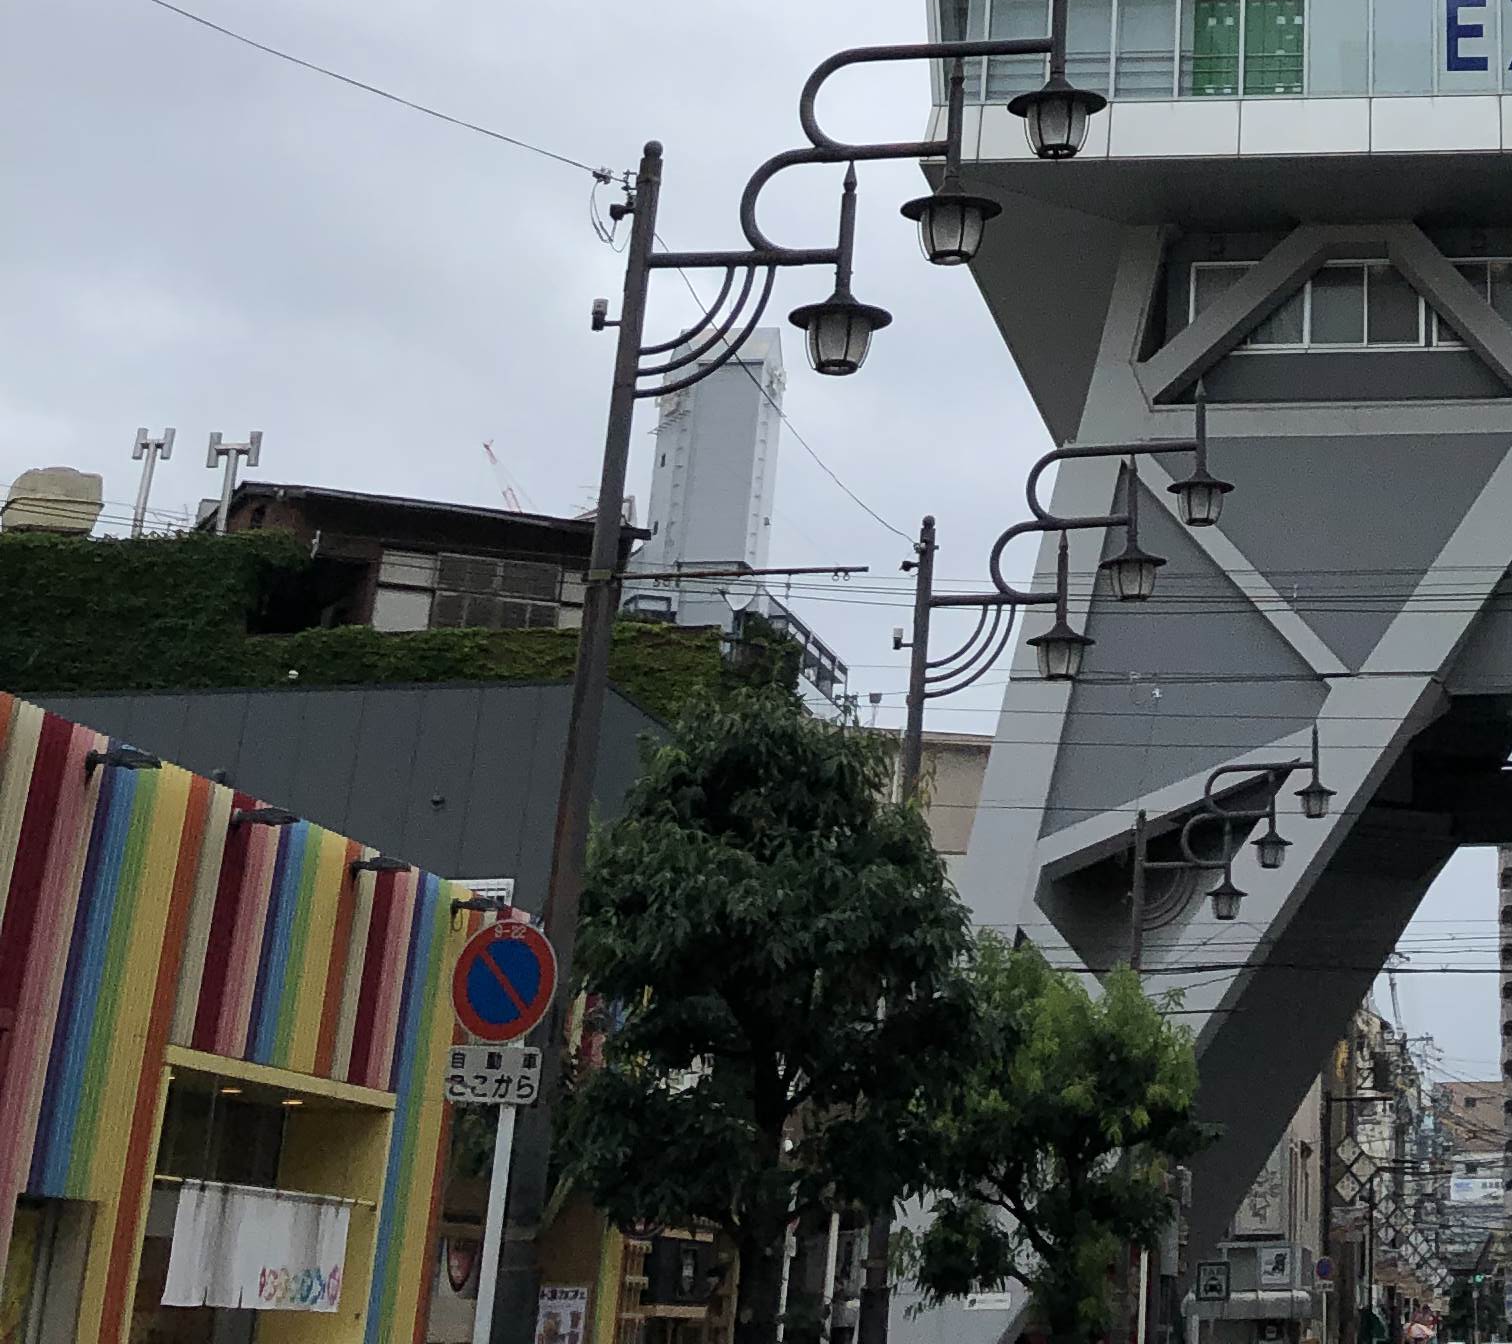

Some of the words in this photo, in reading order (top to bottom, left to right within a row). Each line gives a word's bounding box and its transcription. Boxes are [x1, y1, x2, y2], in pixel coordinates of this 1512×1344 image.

[494, 925, 526, 940] 9-22
[450, 1051, 538, 1070] 自動車
[447, 1074, 535, 1099] ここから
